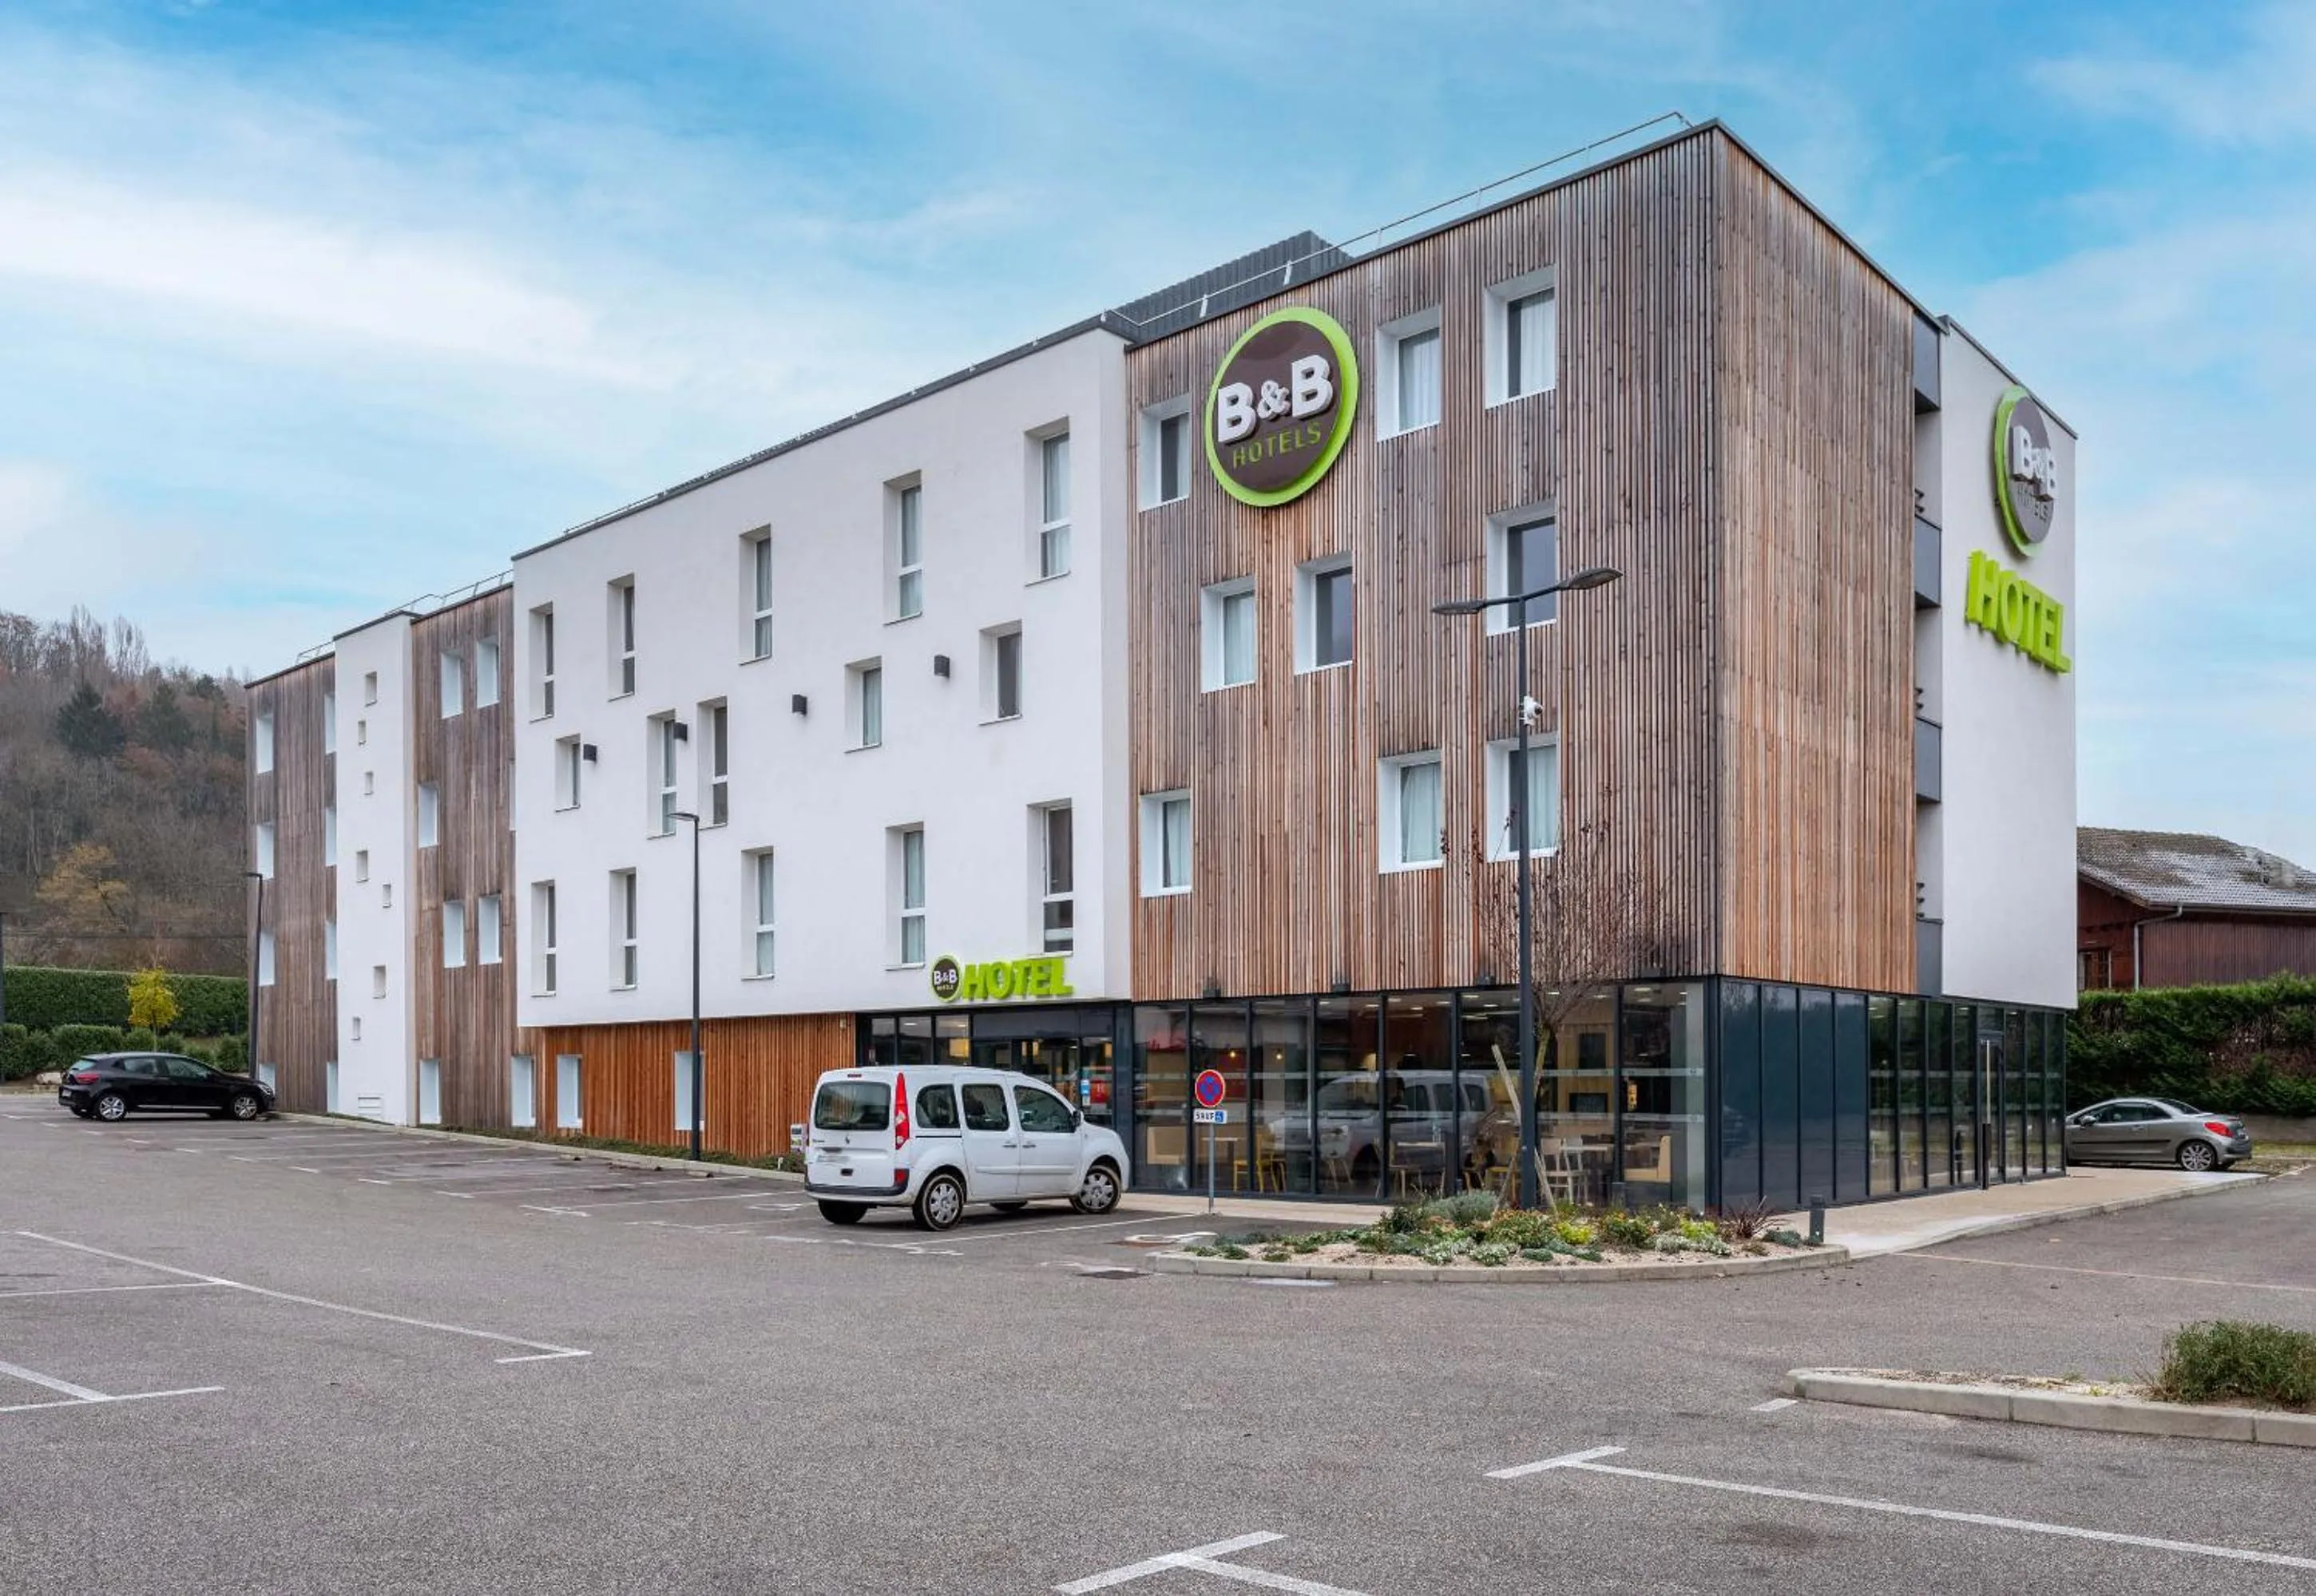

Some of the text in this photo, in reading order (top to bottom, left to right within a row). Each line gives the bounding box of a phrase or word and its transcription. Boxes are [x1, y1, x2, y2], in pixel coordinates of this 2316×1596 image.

[1218, 354, 1333, 442] B&B
[1232, 421, 1322, 469] HOTELS
[1965, 549, 2072, 672] HOTEL
[934, 968, 958, 985] B&B
[962, 958, 1073, 999] HOTEL
